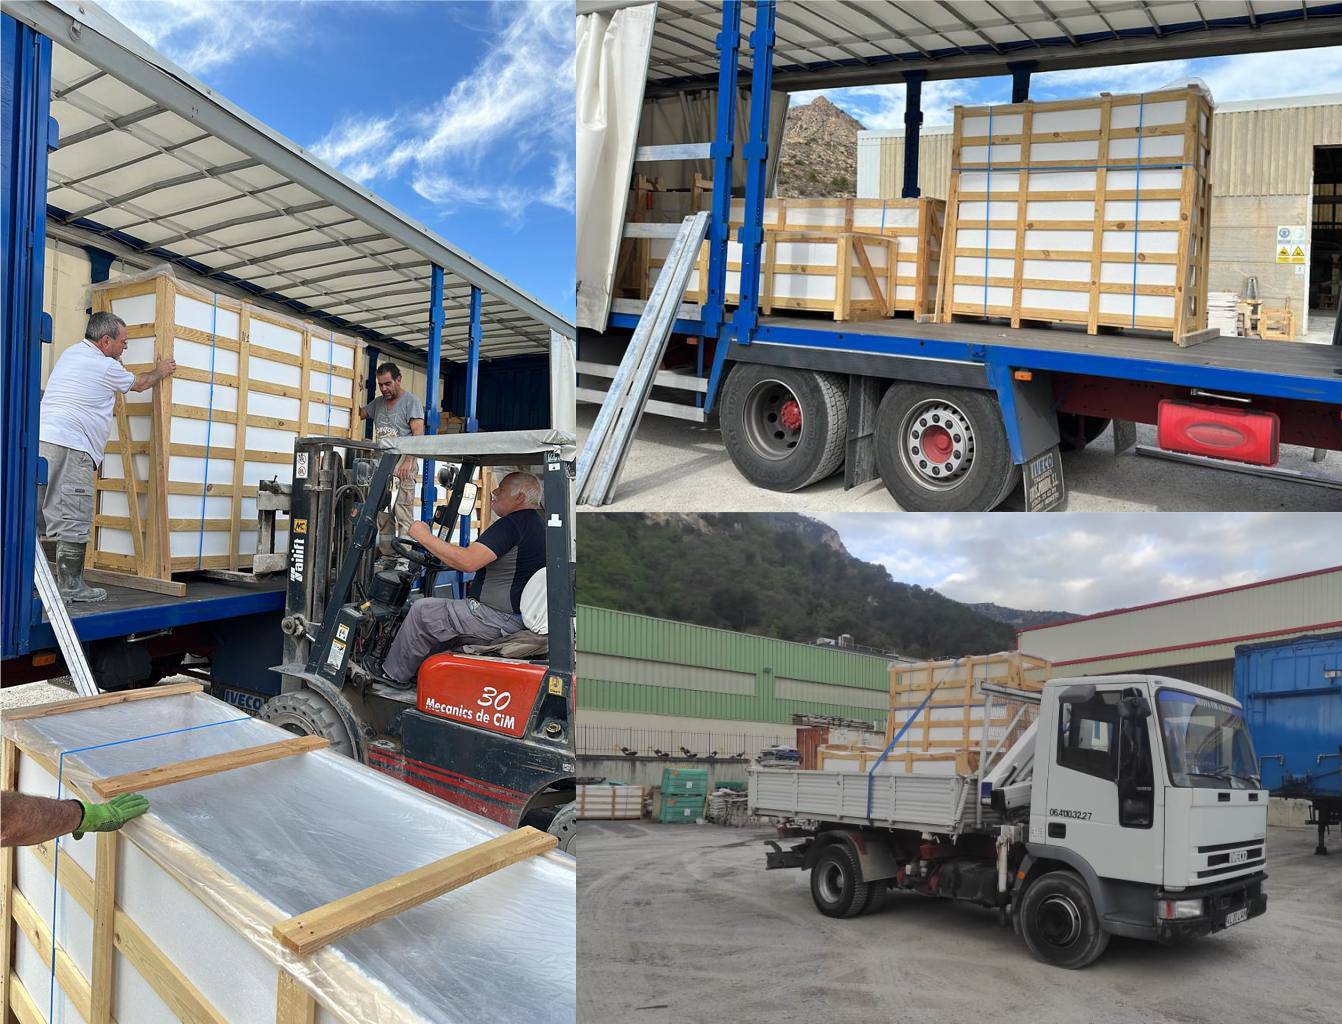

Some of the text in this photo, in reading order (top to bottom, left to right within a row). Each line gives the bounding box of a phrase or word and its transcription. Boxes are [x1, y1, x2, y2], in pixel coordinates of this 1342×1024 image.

[1030, 453, 1054, 479] IVECO
[225, 690, 262, 710] IVECO
[477, 686, 511, 711] 30
[425, 697, 515, 729] Mecanics de CiM
